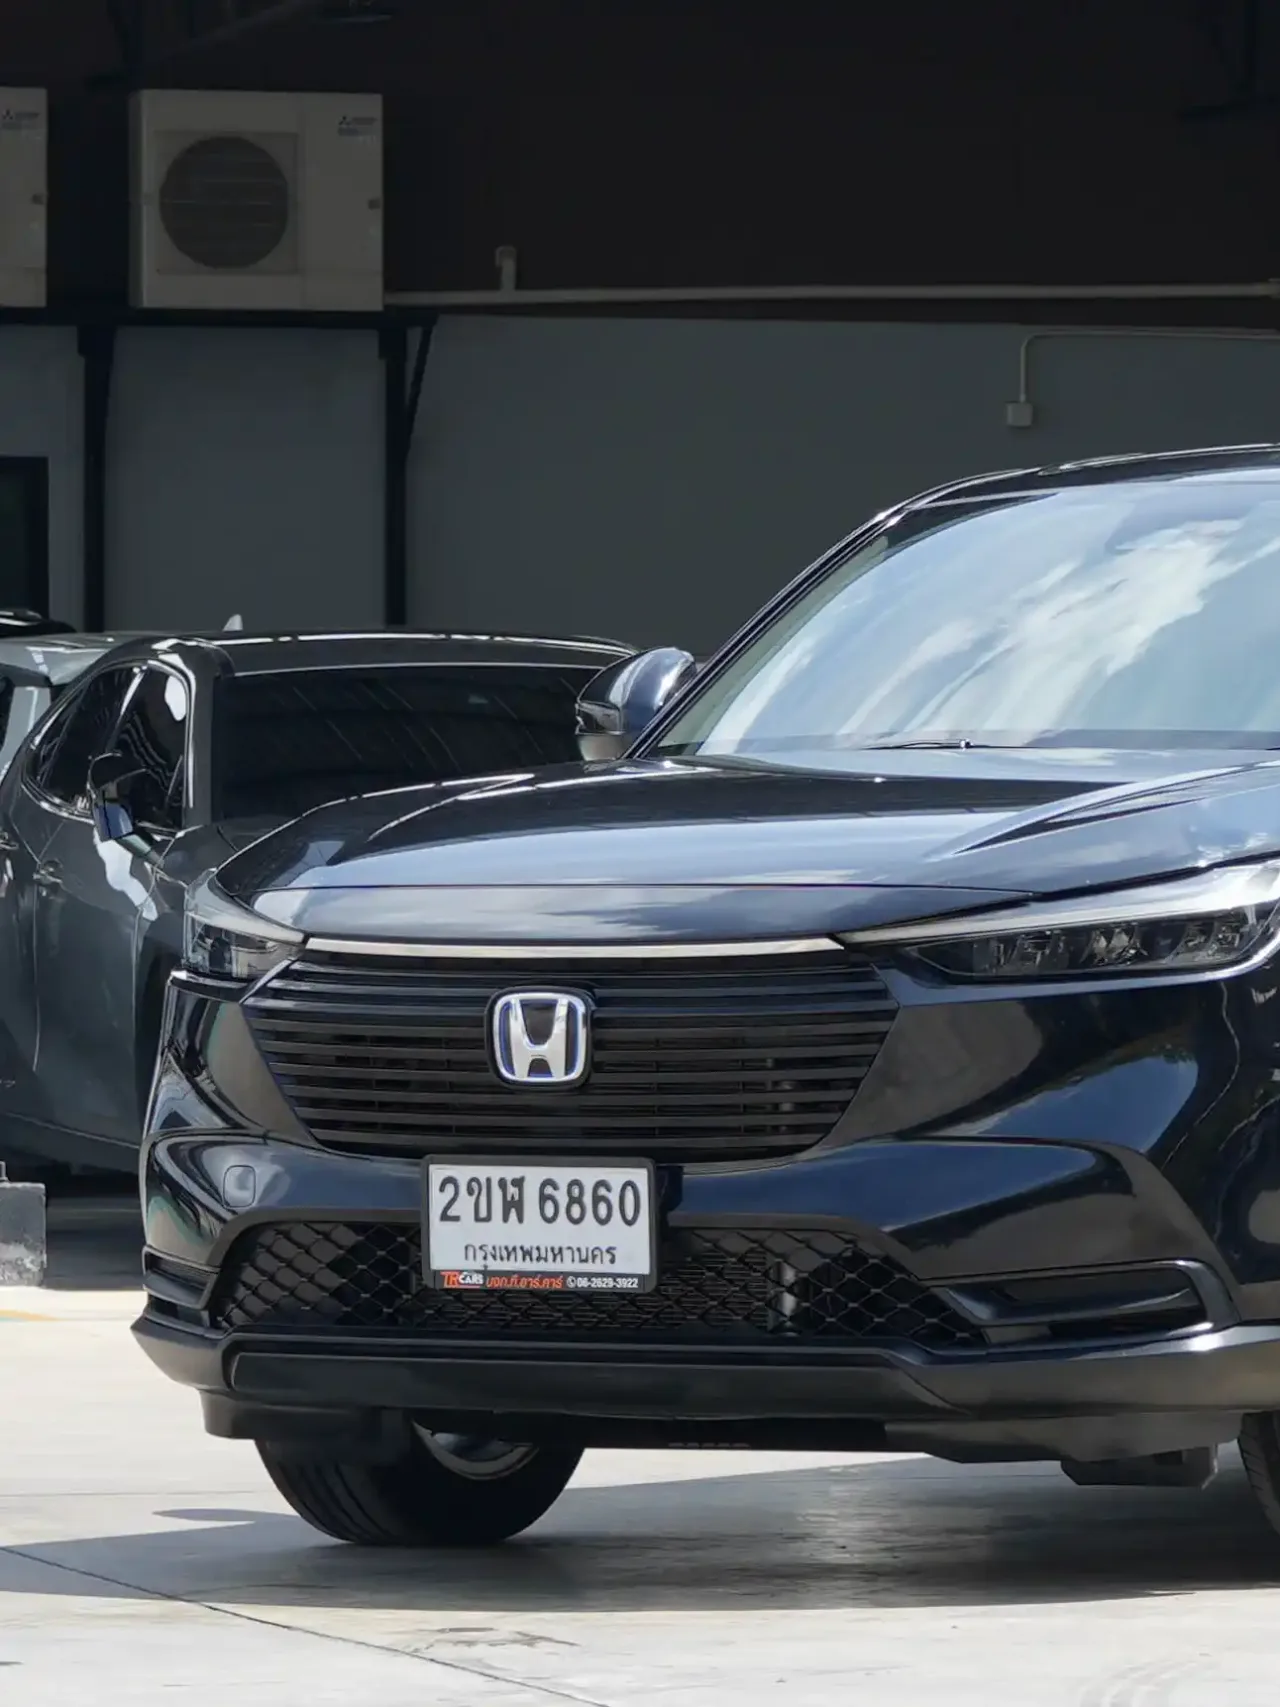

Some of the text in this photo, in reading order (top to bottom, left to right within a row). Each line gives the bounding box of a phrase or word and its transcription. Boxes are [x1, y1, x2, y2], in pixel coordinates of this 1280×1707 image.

[538, 1178, 641, 1226] 6860
[464, 1243, 617, 1266] กรุงเทพมหานคร
